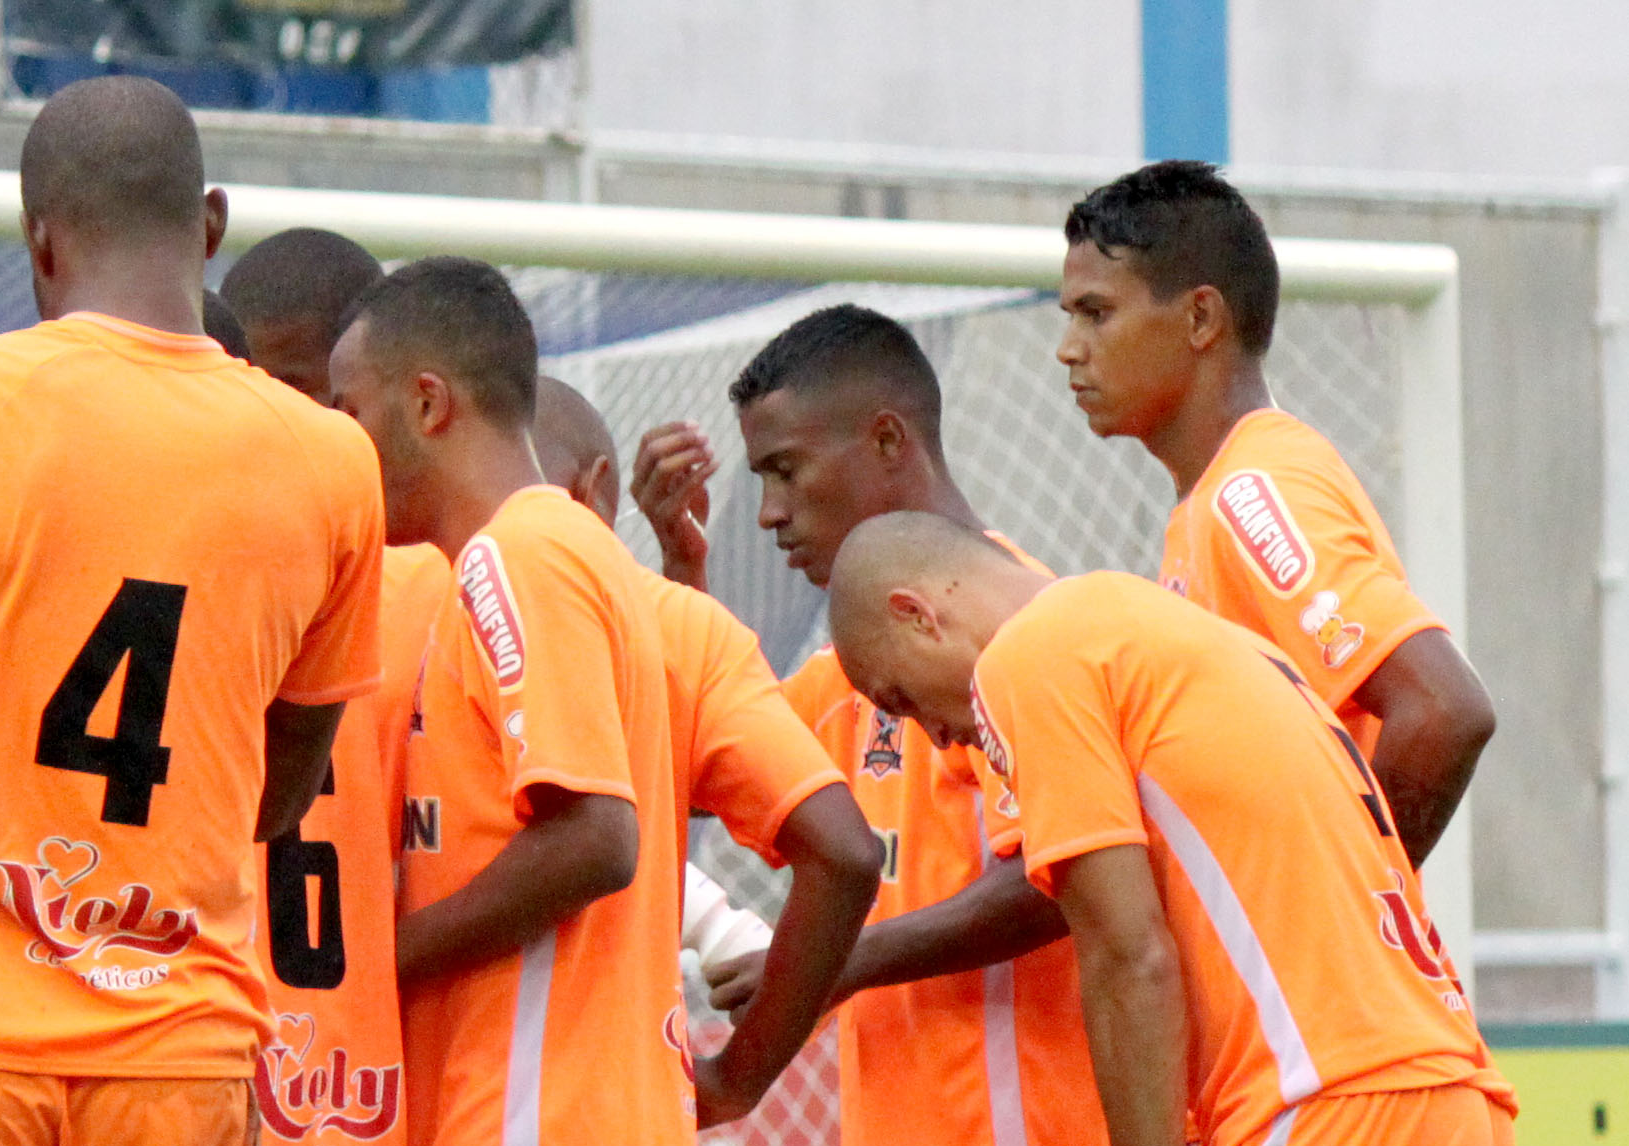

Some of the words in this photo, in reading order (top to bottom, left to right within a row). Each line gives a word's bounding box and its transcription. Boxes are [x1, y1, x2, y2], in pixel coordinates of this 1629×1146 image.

[459, 547, 523, 679] GRANFINO
[1223, 475, 1302, 585] GRANFINO
[34, 576, 189, 828] 4
[266, 752, 347, 990] 6
